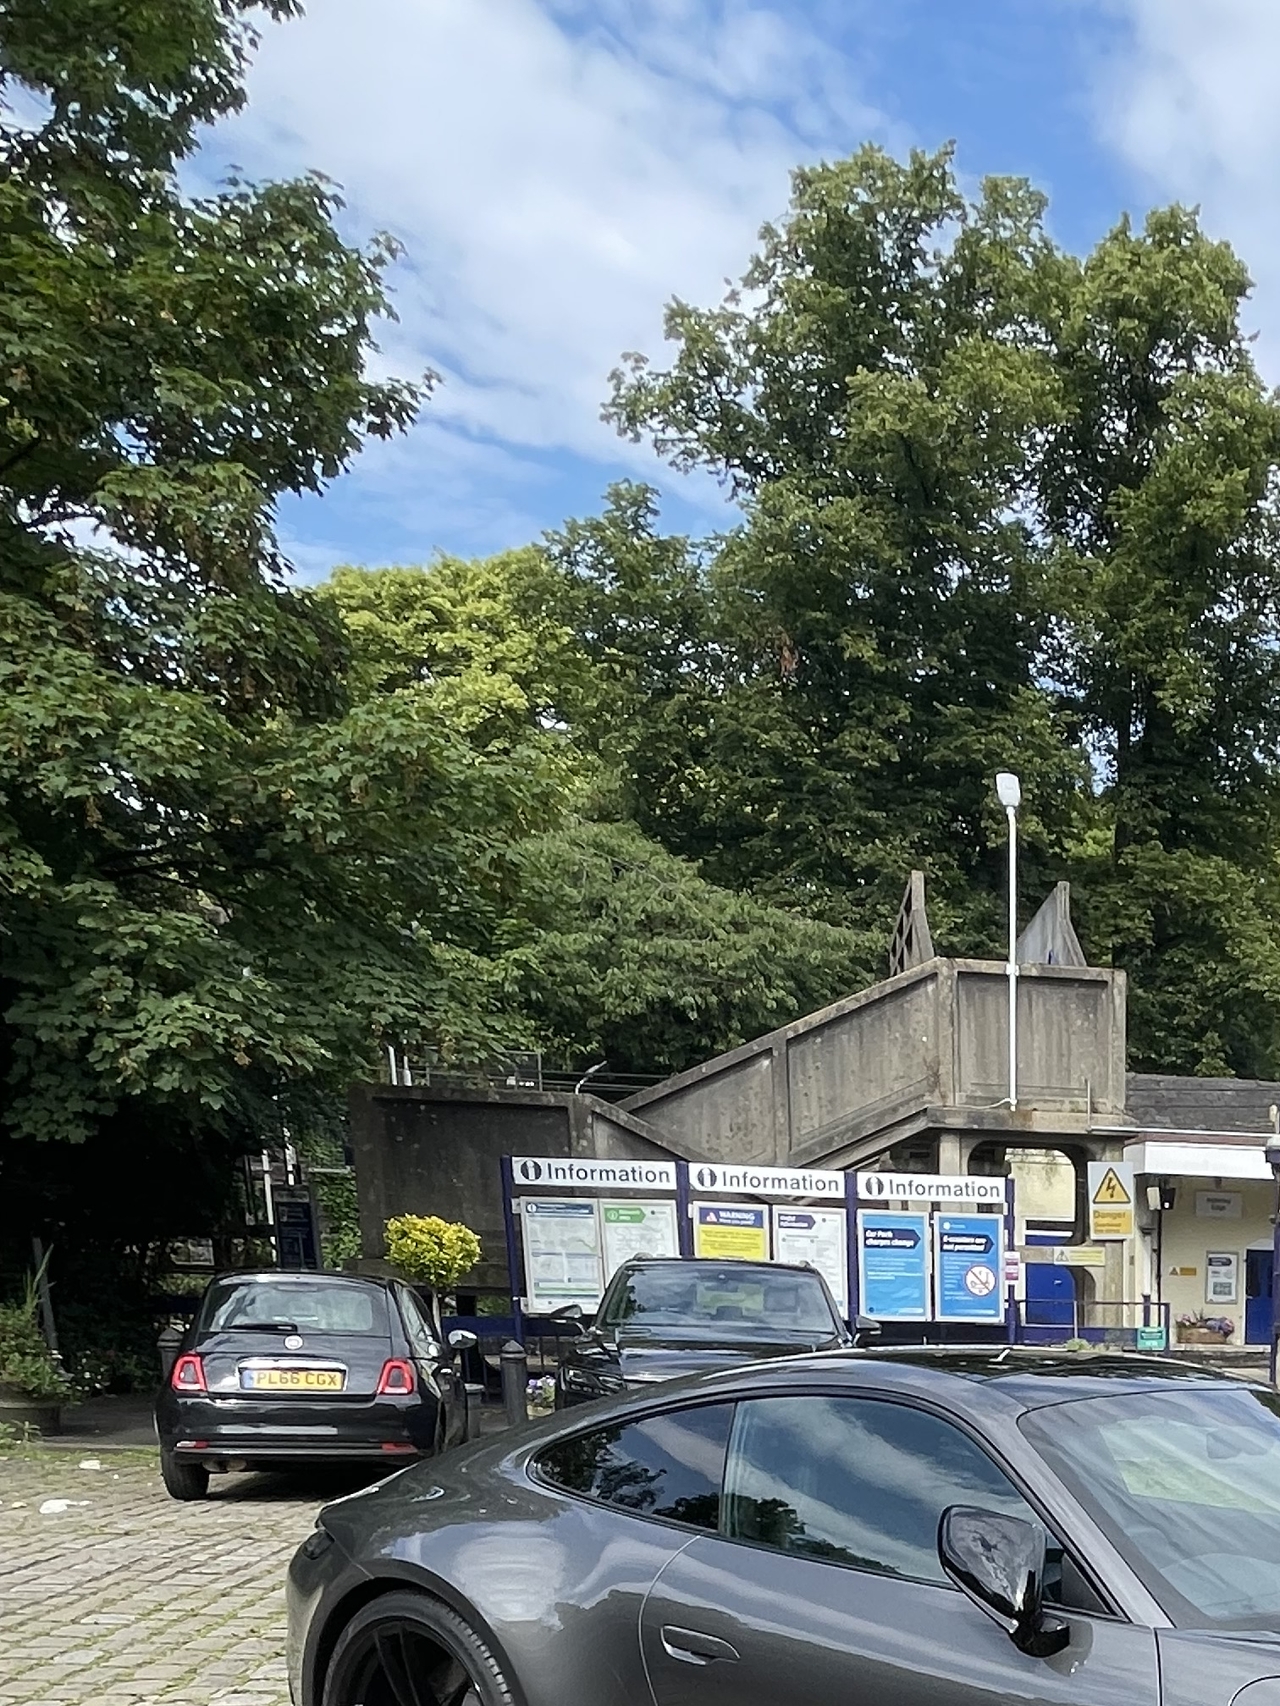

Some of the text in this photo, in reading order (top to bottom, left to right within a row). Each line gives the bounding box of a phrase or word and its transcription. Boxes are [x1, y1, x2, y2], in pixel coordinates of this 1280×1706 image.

[547, 1162, 670, 1183] Information
[722, 1170, 839, 1192] Information
[889, 1178, 1000, 1198] Information
[256, 1371, 338, 1386] PL66 CGX
